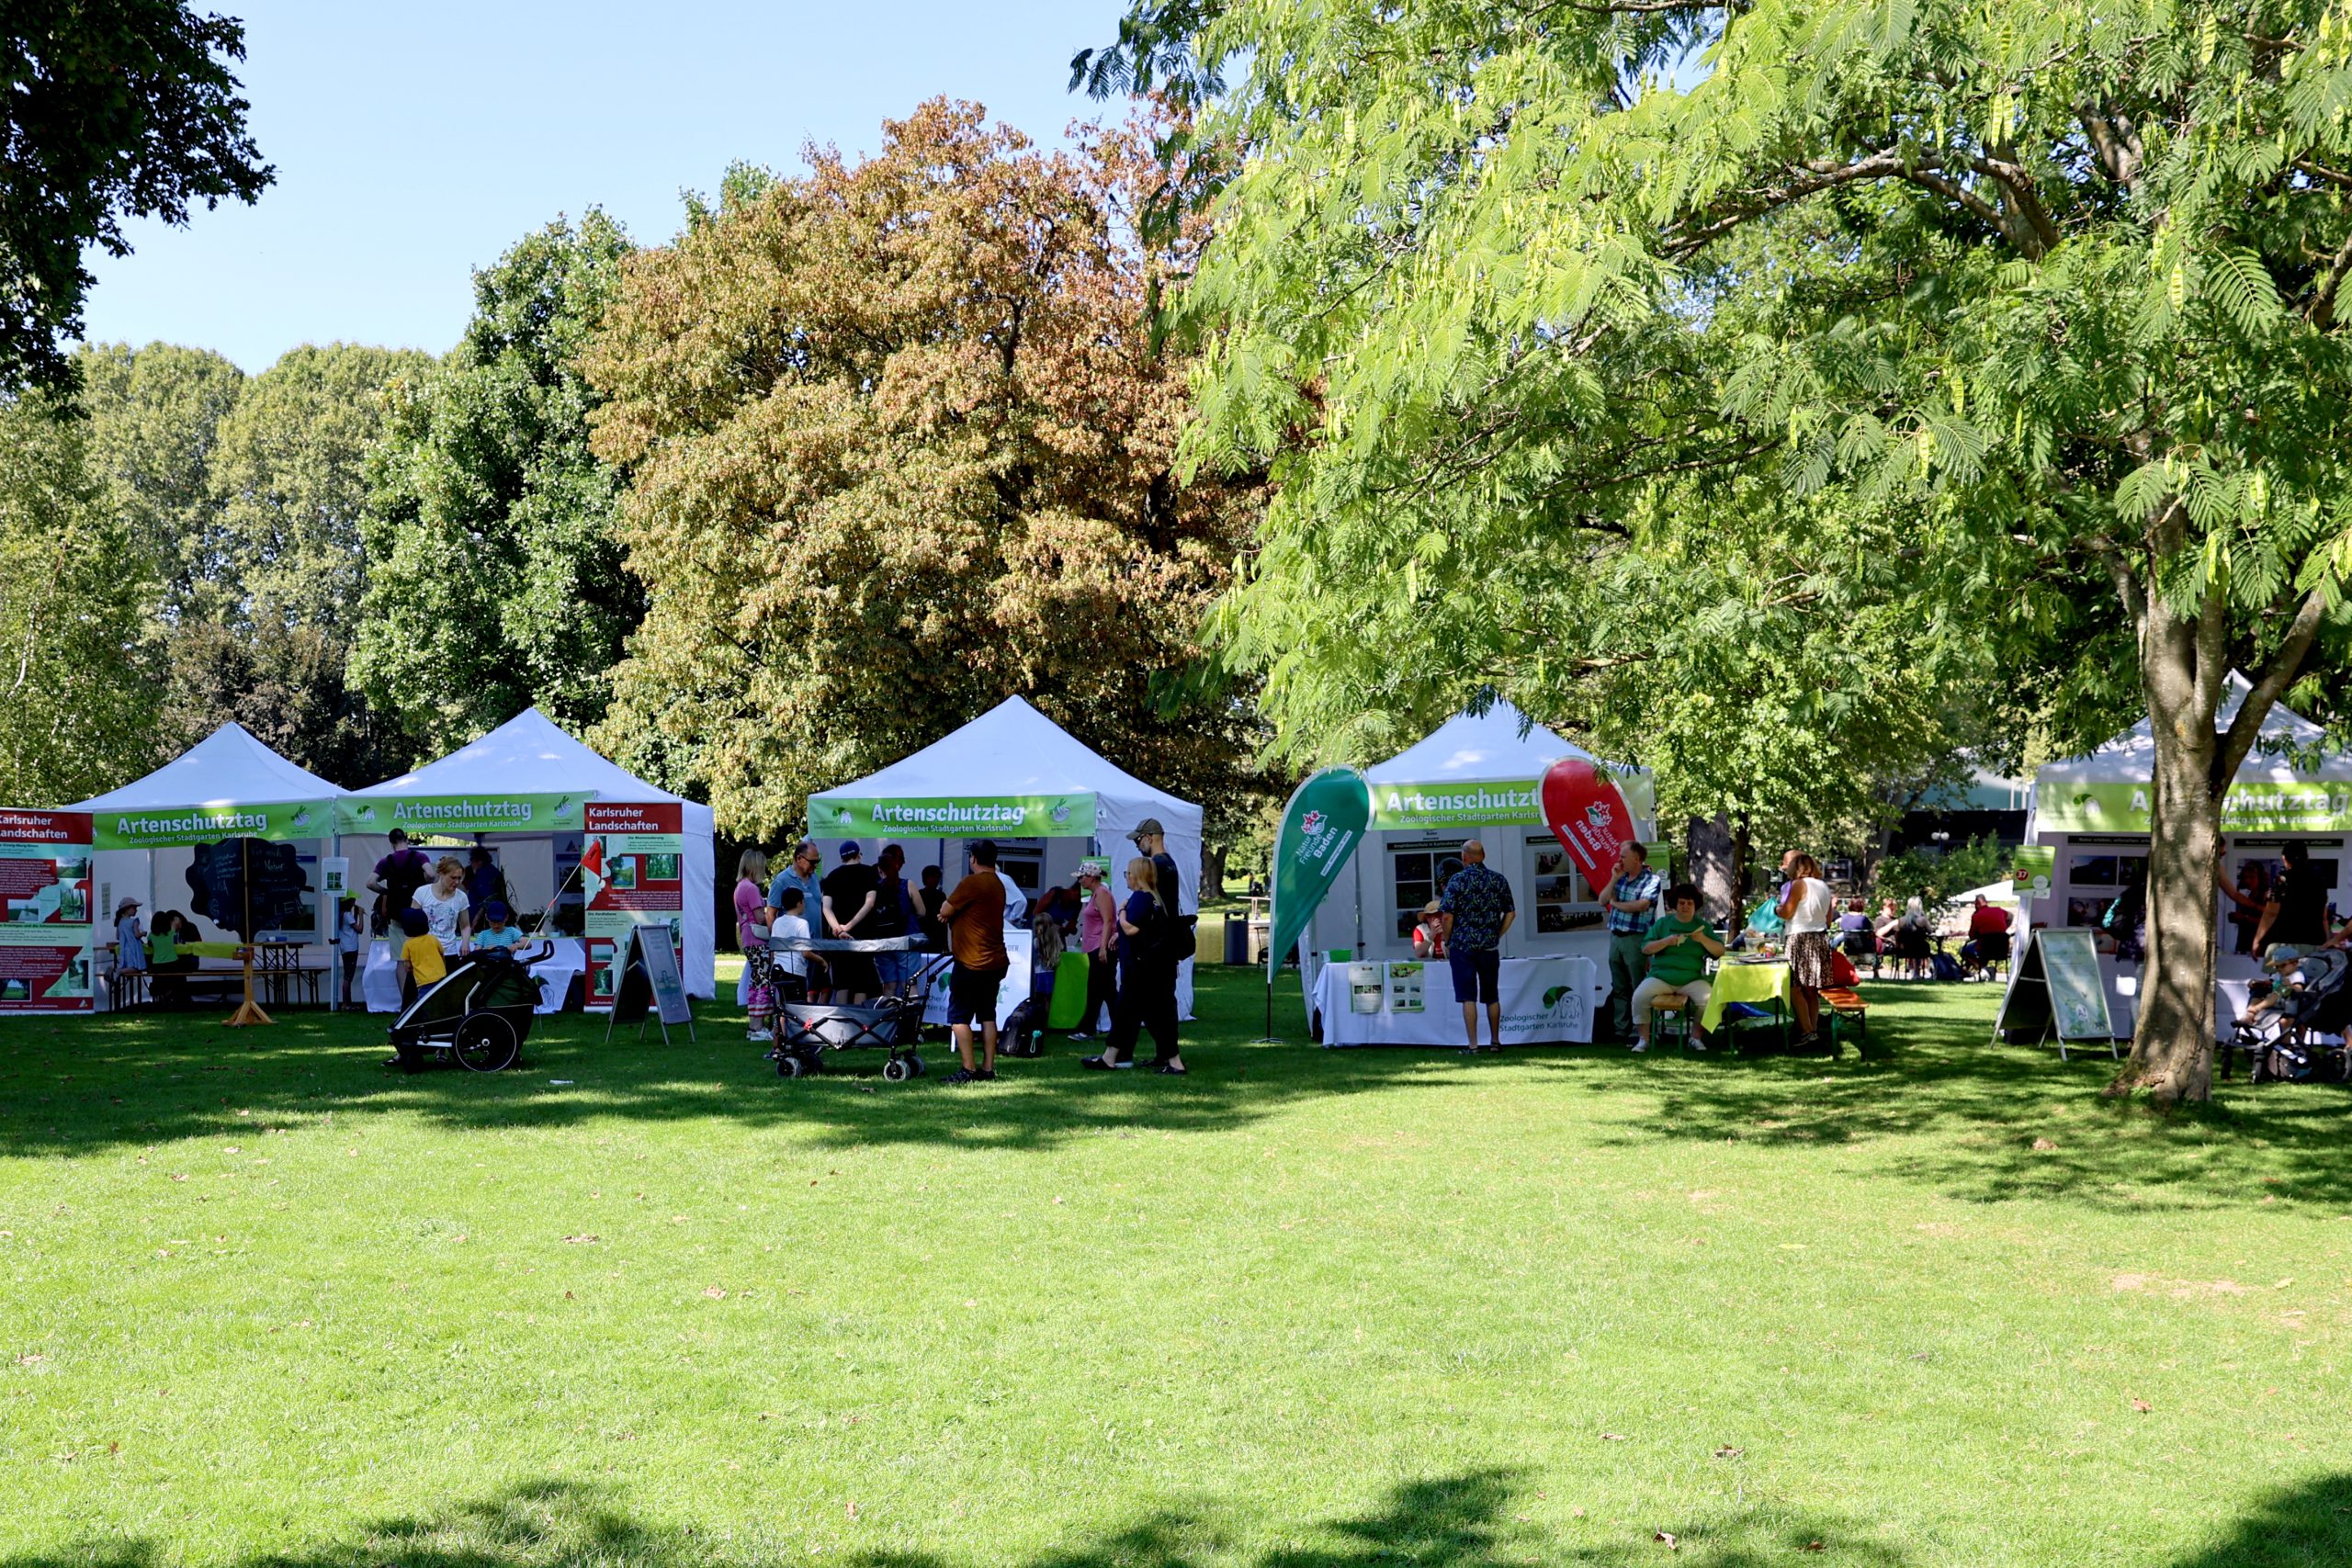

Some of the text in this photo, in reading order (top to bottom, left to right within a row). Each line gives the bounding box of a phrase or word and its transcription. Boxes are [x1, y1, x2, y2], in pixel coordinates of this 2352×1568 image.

[2128, 788, 2349, 816] Achutztag
[393, 799, 532, 821] Artenschutztag
[589, 807, 644, 818] Karlsruher
[871, 802, 1024, 825] Artenschutztag
[1400, 810, 1544, 824] Zoologischer Stadtgarten Karlsr
[117, 812, 266, 834] Artenschutztag
[402, 819, 522, 829] Zoologischer Stadtgarten Karlsruhe
[589, 820, 659, 830] Landschaften
[882, 823, 1013, 834] Zoologischer Stadtgarten Karlsruhe
[0, 829, 68, 839] andschaften
[129, 830, 258, 844] Zoologischer Stadtgarten Karlsruhe
[1295, 835, 1313, 856] Natur
[1299, 833, 1323, 864] Freunde
[1313, 827, 1338, 859] Baden
[1499, 1012, 1548, 1023] Zoologischer
[1499, 1021, 1578, 1032] Stadtgarten Karlsruhe
